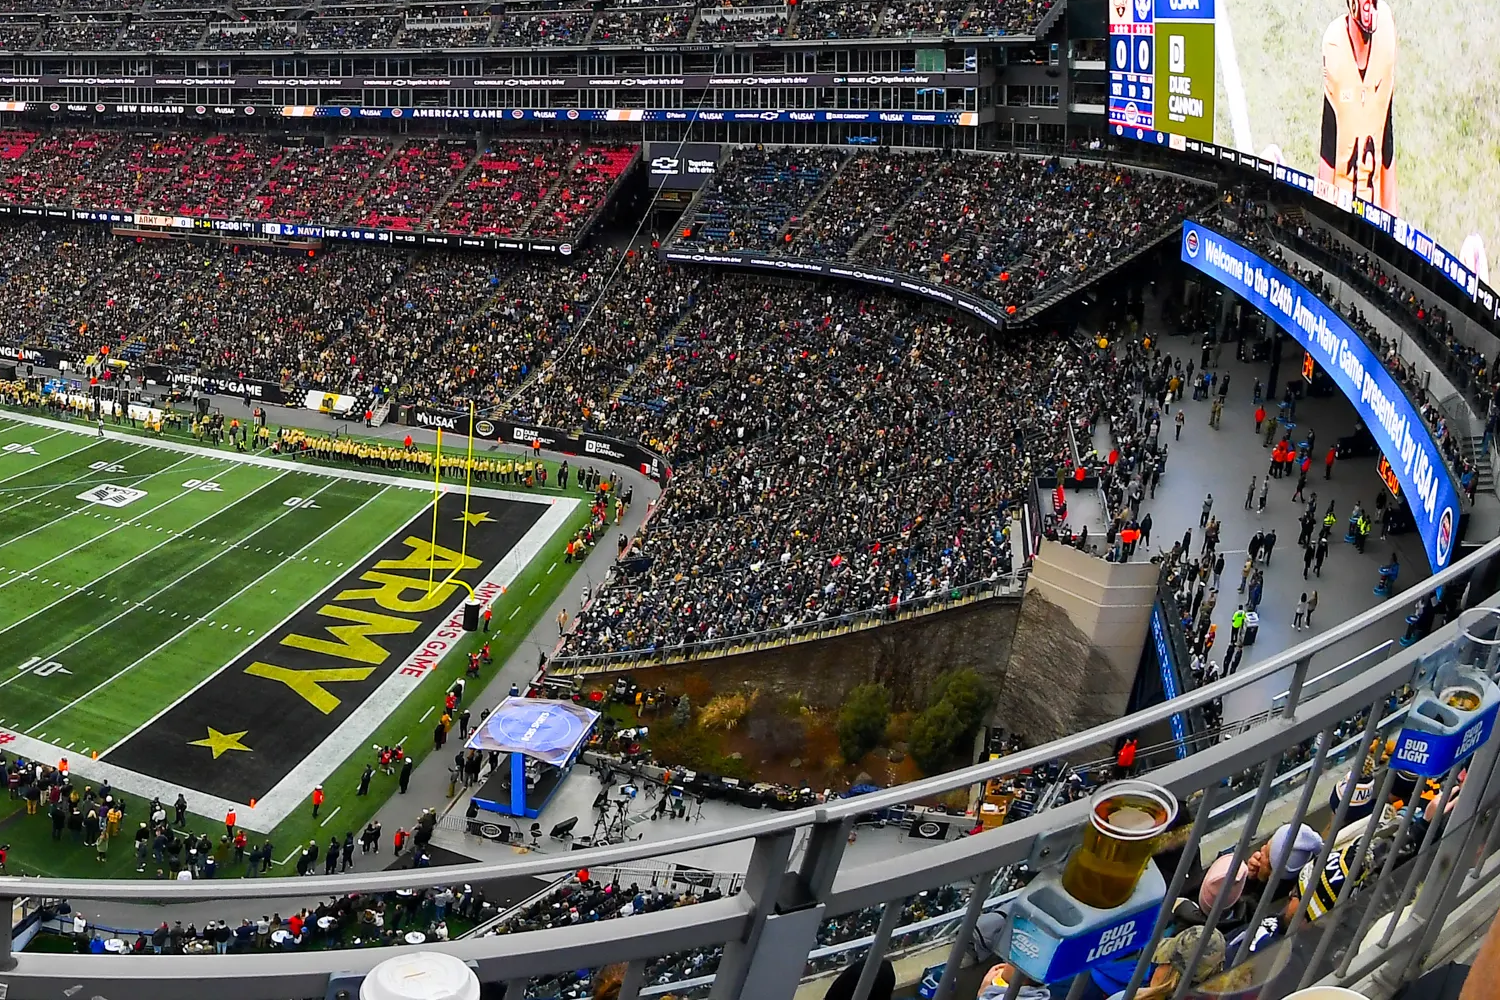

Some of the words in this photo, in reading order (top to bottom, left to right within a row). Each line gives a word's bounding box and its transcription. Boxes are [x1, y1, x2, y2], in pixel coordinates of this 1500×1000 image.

[1116, 39, 1127, 69] 0
[1138, 39, 1150, 70] 0
[1168, 75, 1191, 96] DUKE
[116, 105, 137, 113] NEW
[140, 106, 185, 114] ENGLAND
[412, 109, 469, 118] AMERICA'S
[473, 109, 503, 118] GAME
[1168, 96, 1203, 118] CANNON
[706, 112, 724, 120] USAA
[798, 112, 815, 120] USAA
[687, 160, 714, 168] Together
[76, 212, 89, 220] 1ST
[138, 216, 158, 224] ARMY
[215, 221, 239, 230] 12:06
[297, 227, 321, 236] NAVY
[325, 229, 340, 237] 1ST
[350, 231, 360, 239] 10
[166, 370, 228, 391] AMERIC'S
[228, 382, 262, 396] GAME
[1204, 237, 1243, 281] Welcome
[1243, 261, 1253, 287] to
[1254, 267, 1269, 298] the
[1269, 277, 1293, 316] 124th
[1292, 296, 1340, 365] Army-Navy
[1339, 338, 1364, 390] Game
[1361, 371, 1406, 452] presented
[1401, 421, 1416, 476] by
[1413, 444, 1439, 523] USAA
[429, 414, 457, 429] USAA
[524, 429, 539, 438] DUKE
[2, 442, 34, 455] 40
[596, 442, 611, 451] DUKE
[88, 460, 121, 473] 30
[182, 478, 218, 492] 20
[283, 497, 314, 509] 10
[437, 581, 501, 640] AMEICA'S
[243, 535, 483, 715] ARMY
[17, 656, 63, 677] 10
[399, 640, 447, 679] GAME
[1464, 720, 1484, 742] BUD
[1404, 738, 1428, 752] BUD
[1454, 730, 1483, 759] LIGHT
[1397, 747, 1430, 765] LIGHT
[1326, 851, 1344, 884] AVY
[1099, 919, 1136, 947] BUD
[1016, 933, 1041, 954] BUD
[1085, 930, 1138, 964] LIGHT
